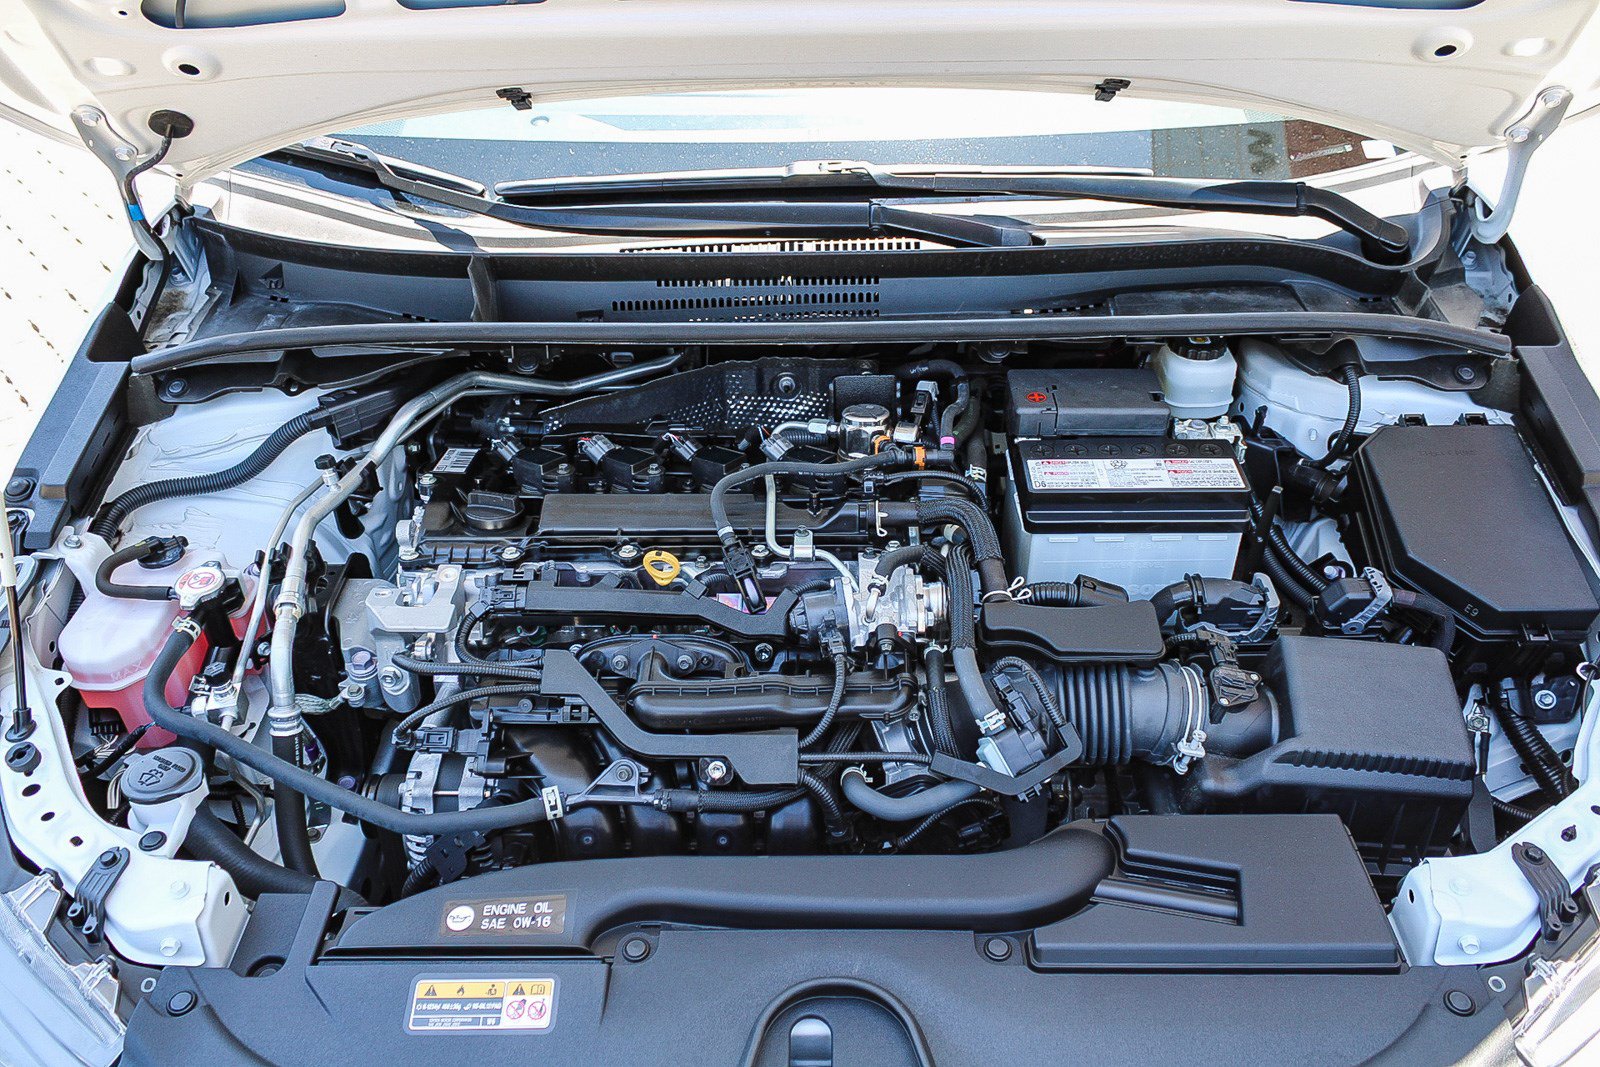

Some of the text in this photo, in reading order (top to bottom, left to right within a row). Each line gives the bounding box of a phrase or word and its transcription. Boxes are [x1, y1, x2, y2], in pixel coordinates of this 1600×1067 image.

[1464, 604, 1479, 617] E9
[110, 661, 143, 682] MAX
[482, 901, 553, 916] ENGINE OIL
[480, 915, 551, 930] SAE 0W-16
